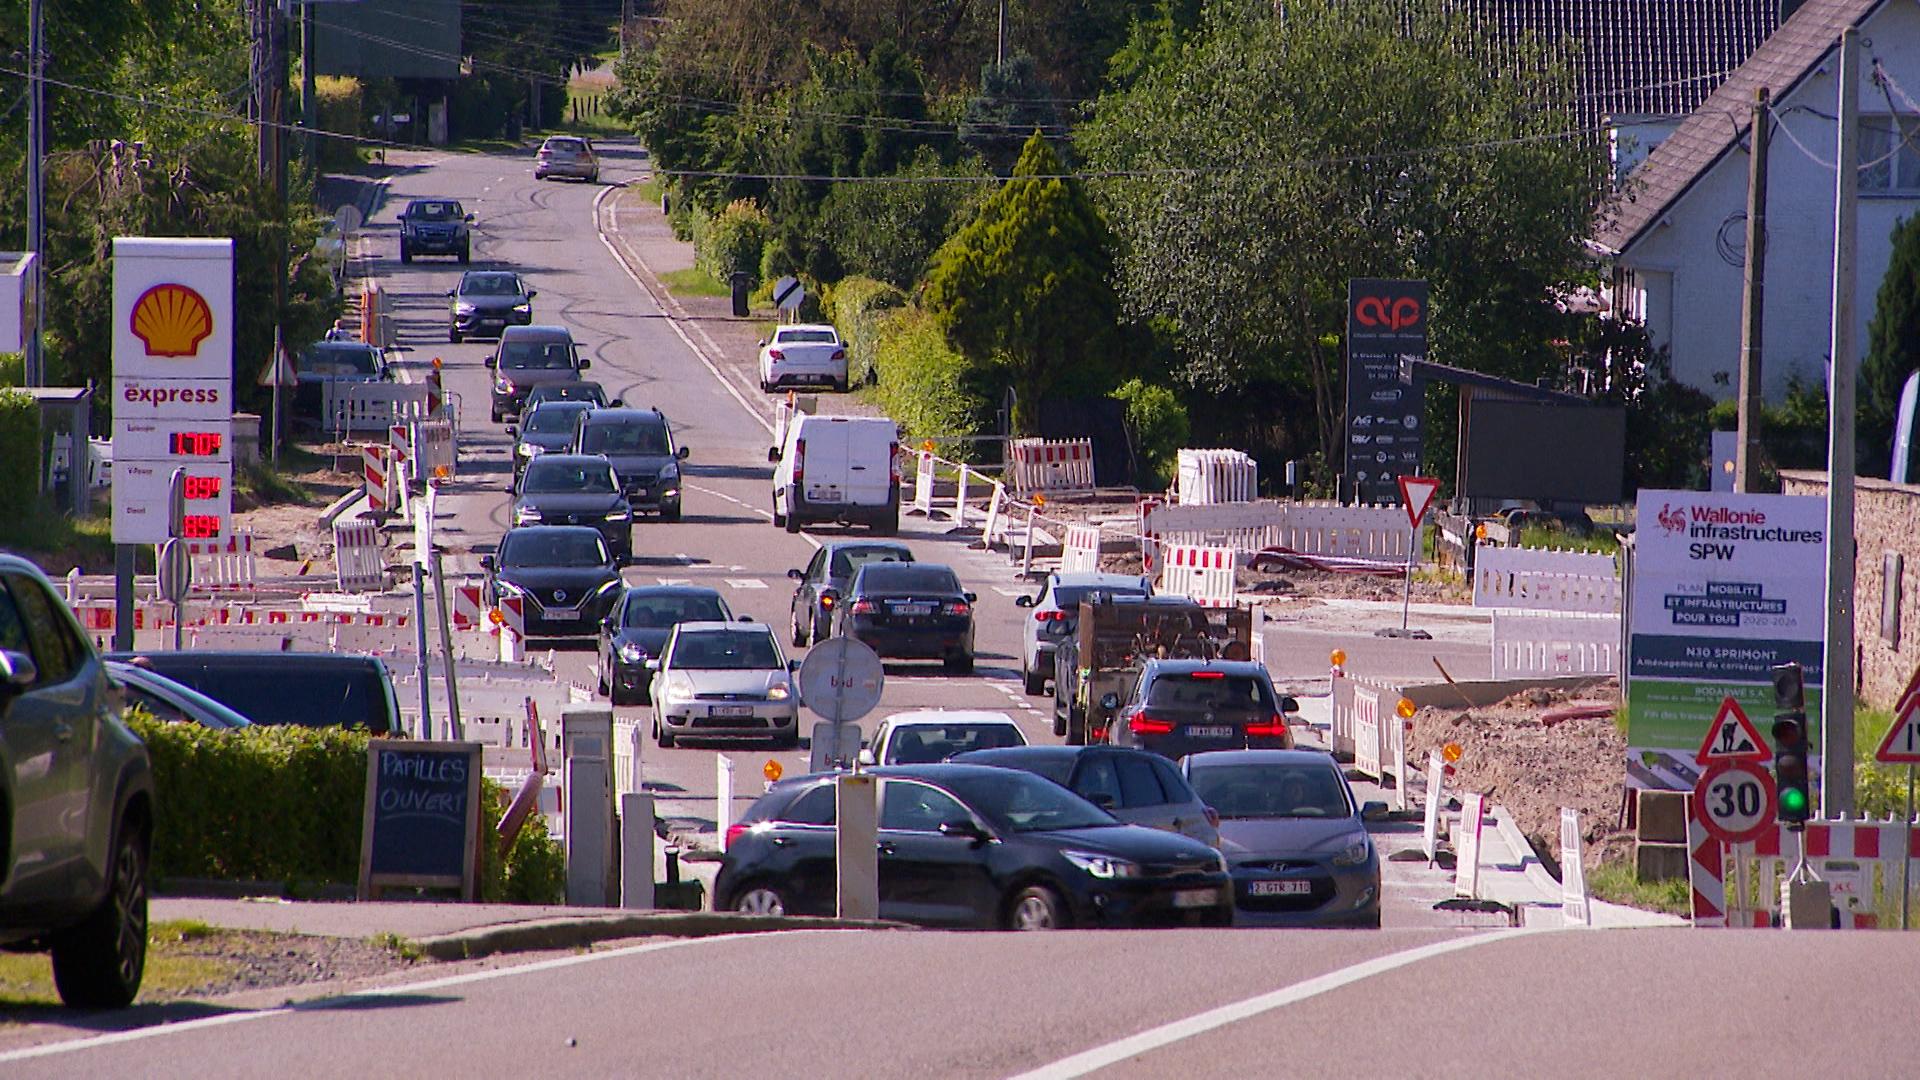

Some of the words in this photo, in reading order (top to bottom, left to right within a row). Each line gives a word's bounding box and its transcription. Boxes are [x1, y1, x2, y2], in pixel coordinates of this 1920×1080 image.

[124, 388, 218, 408] express
[1691, 506, 1766, 524] Wallonie
[1690, 524, 1822, 543] infrastructures
[1689, 543, 1735, 561] SPW
[1677, 584, 1704, 593] PLAN
[1667, 597, 1681, 607] ET
[1685, 598, 1784, 612] INFRASTRUCTURES
[1676, 613, 1705, 624] POUR
[1709, 613, 1738, 625] TOUS
[1686, 647, 1711, 658] N30
[1715, 649, 1778, 661] SPRIMONT
[1637, 658, 1704, 669] Aménagement
[1721, 663, 1763, 673] carrefour
[381, 788, 464, 812] OUVERT
[1712, 782, 1760, 818] 30
